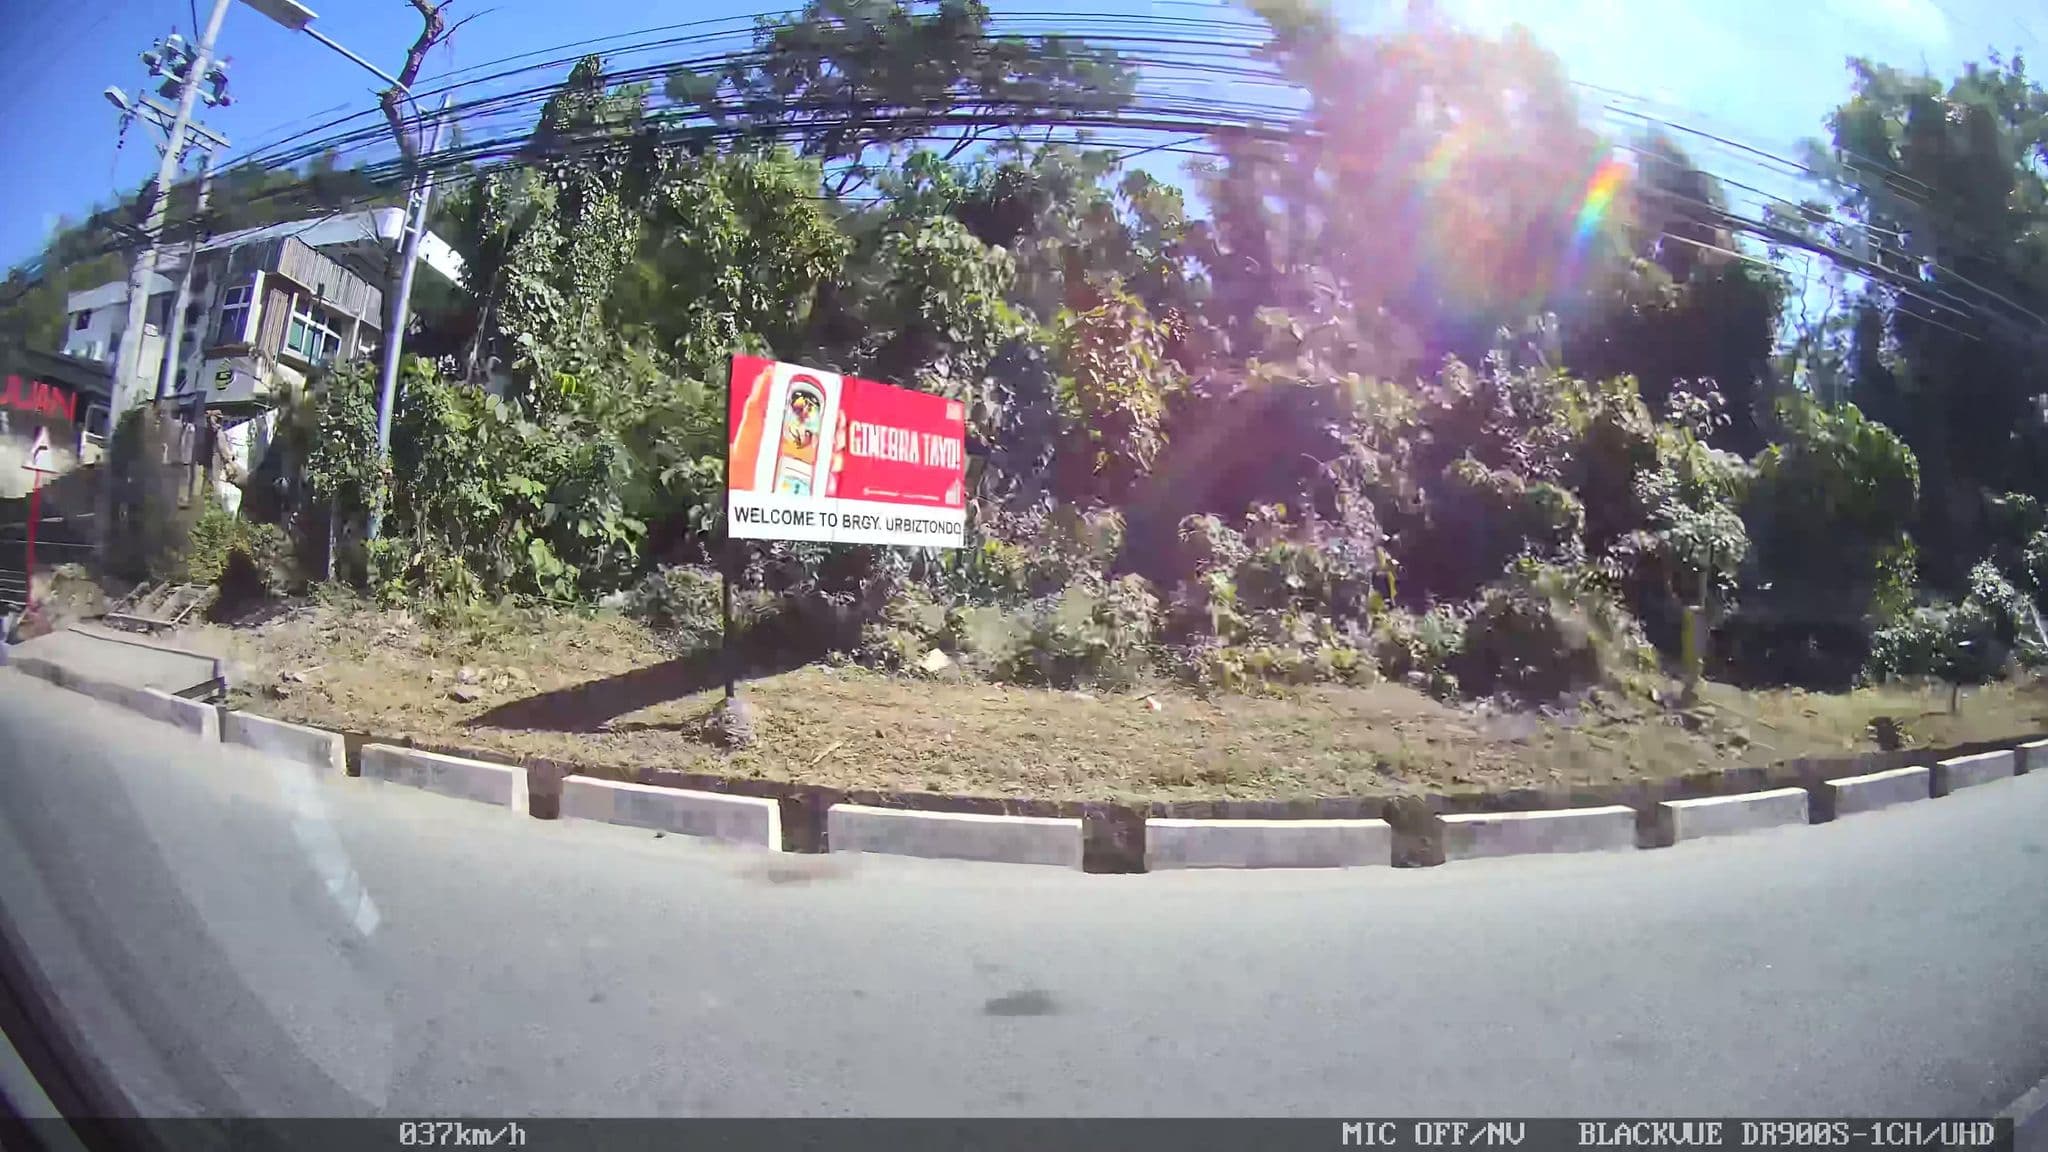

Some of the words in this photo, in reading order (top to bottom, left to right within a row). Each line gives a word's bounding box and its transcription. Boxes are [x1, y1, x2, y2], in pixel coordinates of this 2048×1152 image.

[849, 420, 919, 464] GINEBRA
[922, 433, 960, 470] TAYO!
[734, 506, 815, 527] WELCOME
[819, 512, 838, 528] TO
[842, 514, 882, 531] BRGY.
[886, 517, 962, 535] URBIZTONDO
